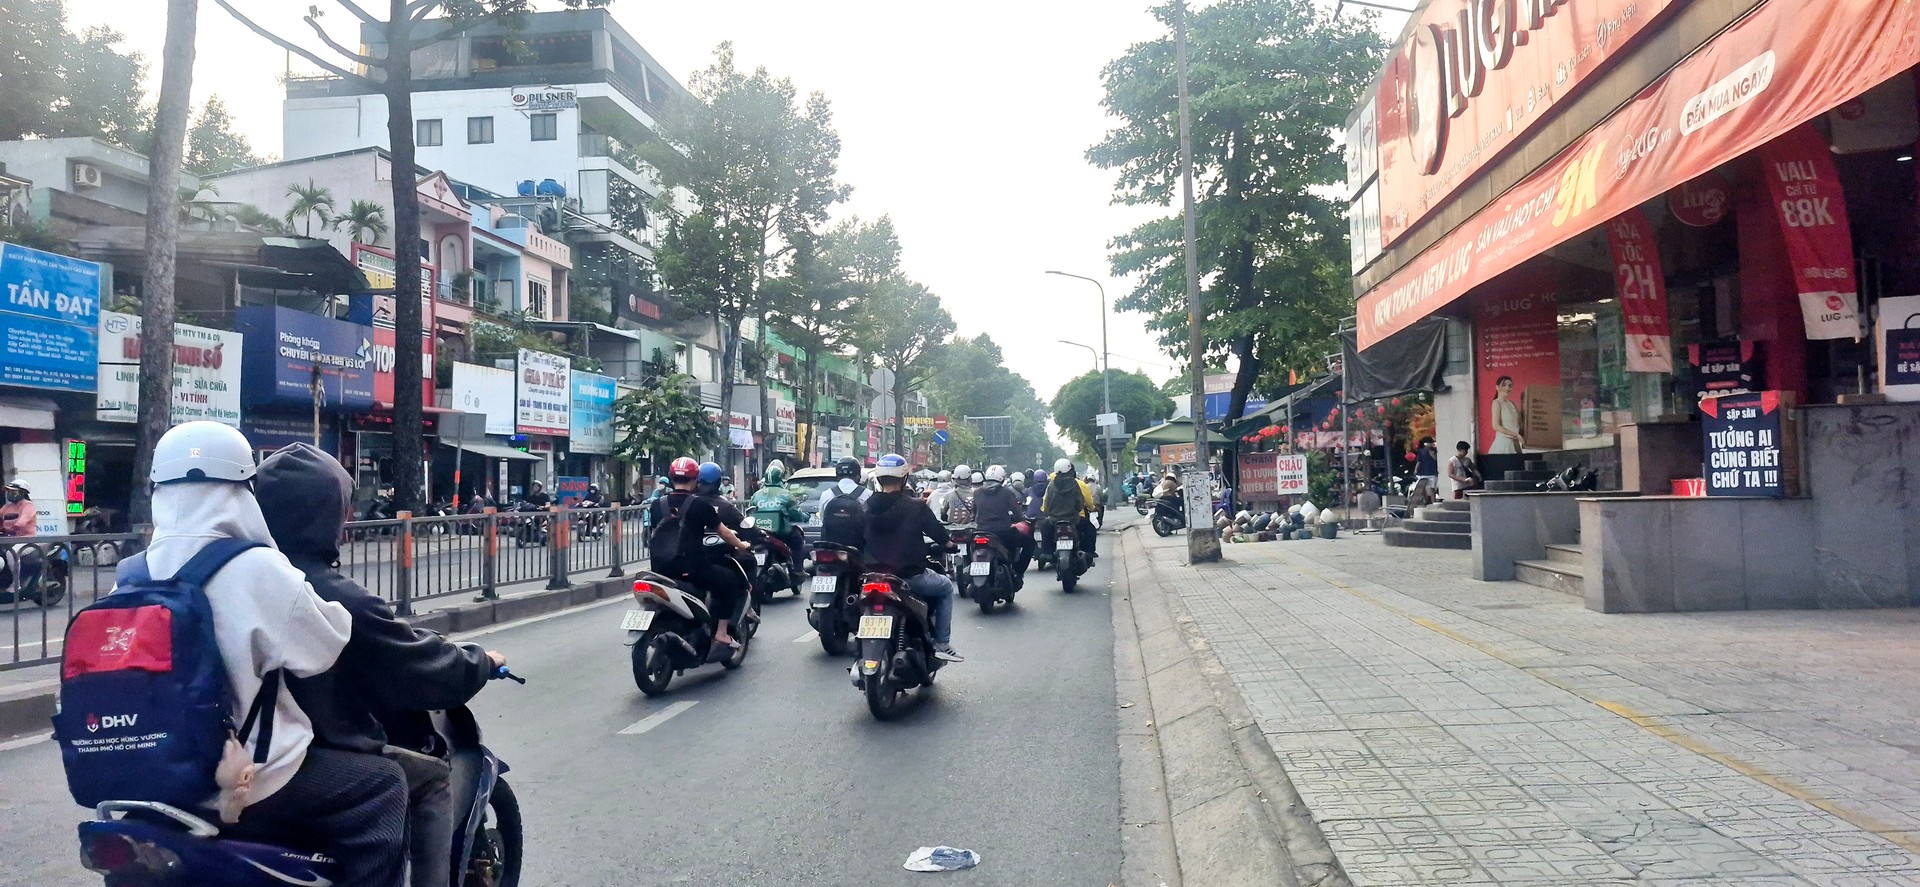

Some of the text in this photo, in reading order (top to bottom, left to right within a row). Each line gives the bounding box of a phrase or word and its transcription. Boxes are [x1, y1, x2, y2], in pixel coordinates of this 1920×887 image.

[528, 92, 574, 102] PILSNER
[1686, 65, 1768, 129] ĐẾN MUA NGAY!
[1776, 160, 1817, 182] VALI
[1552, 140, 1607, 228] 9K
[1511, 197, 1535, 232] HOT
[1781, 196, 1835, 228] 88K
[1374, 294, 1392, 327] NEW
[1392, 273, 1422, 315] TOUCH
[1420, 252, 1448, 302] NEW
[1618, 263, 1657, 300] 2H
[7, 278, 92, 320] TẤN ĐẠT
[106, 318, 128, 331] HTS
[1821, 313, 1841, 322] LUG
[182, 330, 196, 338] MTV
[197, 331, 206, 339] TM
[280, 332, 301, 346] Phòng
[202, 343, 224, 370] SỐ
[280, 346, 308, 361] CHUYÊN
[116, 371, 134, 382] LINH
[194, 378, 207, 390] SỬA
[209, 380, 227, 392] CHỮA
[180, 392, 208, 404] VI TÍNH
[1726, 408, 1740, 421] SẬP
[1709, 426, 1772, 448] TƯỞNG AI
[1711, 446, 1779, 468] CŨNG BIẾT
[1712, 468, 1778, 488] CHỨ TA !!!
[757, 500, 781, 508] Grab
[102, 714, 138, 728] DHV
[140, 732, 167, 741] VƯƠNG
